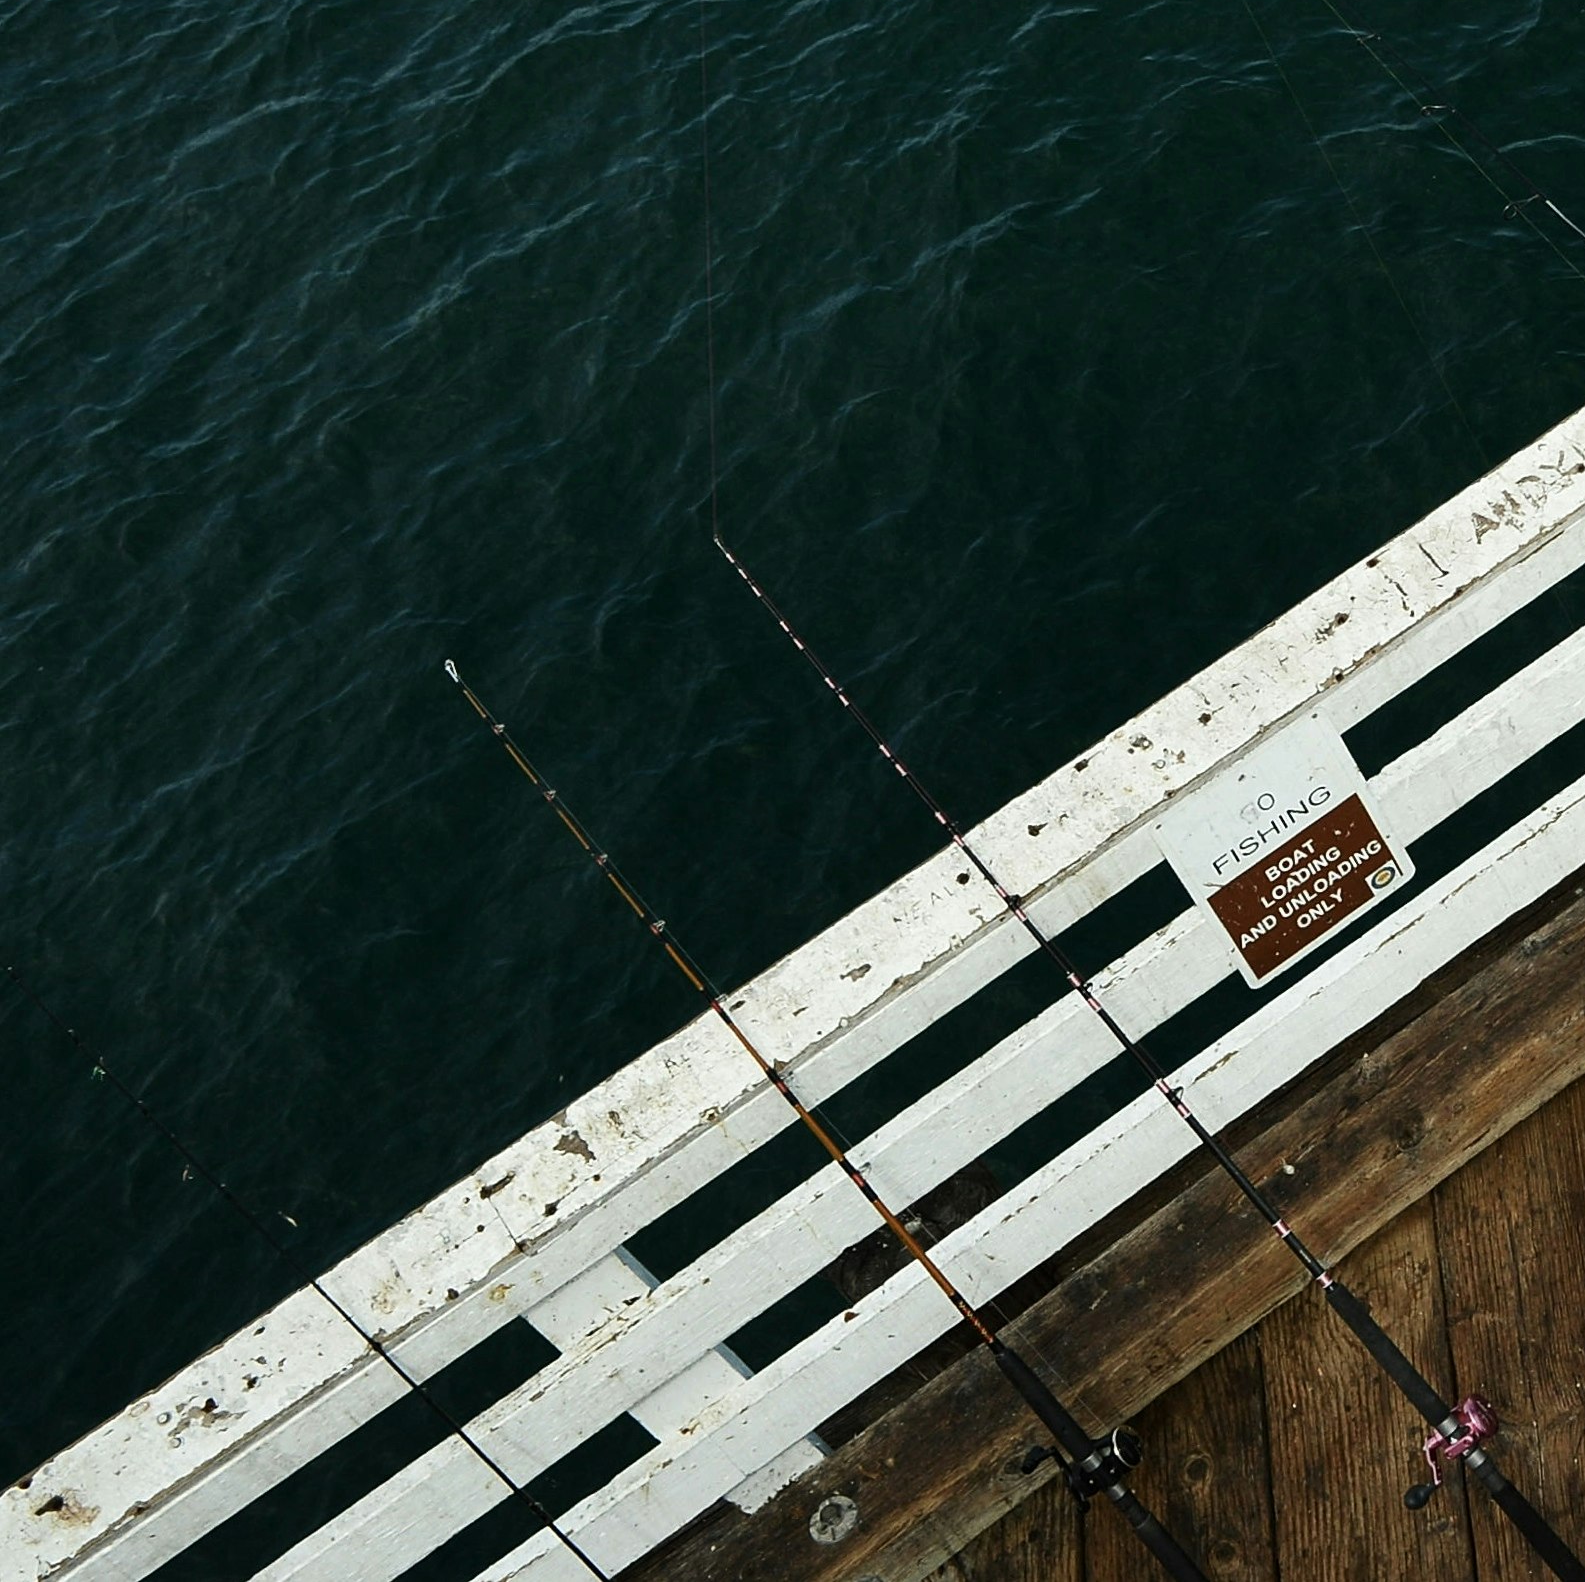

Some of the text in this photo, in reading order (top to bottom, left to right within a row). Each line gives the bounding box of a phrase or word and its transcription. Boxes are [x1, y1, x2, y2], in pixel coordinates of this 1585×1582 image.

[1211, 785, 1332, 876] FISHING
[1264, 838, 1317, 882] BOAT
[1239, 914, 1277, 949] AND
[1278, 839, 1383, 919] UNLOADING
[1260, 845, 1342, 909] LOADING
[1296, 888, 1345, 929] ONLY
